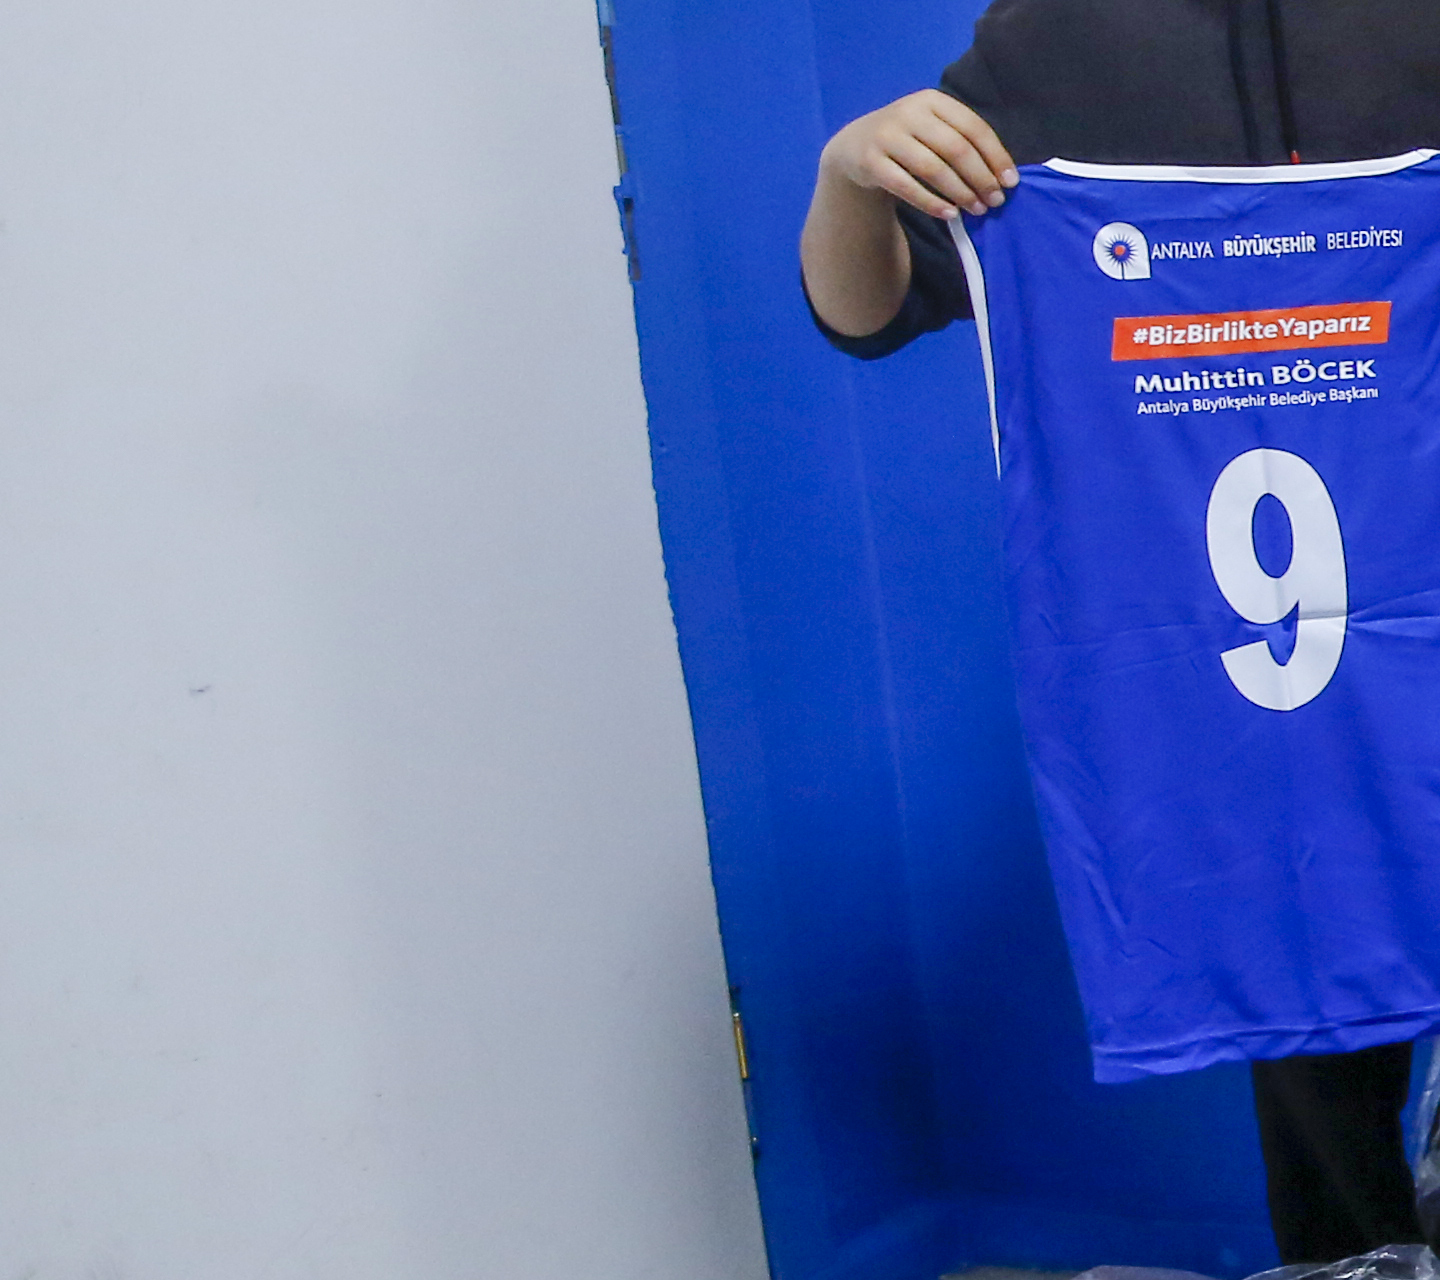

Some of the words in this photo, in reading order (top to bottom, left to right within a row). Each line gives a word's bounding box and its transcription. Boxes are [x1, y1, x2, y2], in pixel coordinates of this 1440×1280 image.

[1151, 240, 1214, 260] ANTALYA
[1223, 233, 1317, 258] BÜYÜKŞEHİR
[1132, 315, 1371, 346] #BizBirlikteYaparız
[1134, 368, 1264, 394] Muhittin
[1271, 358, 1377, 385] BÖCEK
[1136, 400, 1189, 417] Antalya
[1193, 394, 1266, 413] Büyükşehir
[1270, 389, 1327, 407] Belediye
[1329, 386, 1379, 404] Başkanı
[1204, 446, 1349, 711] 9
